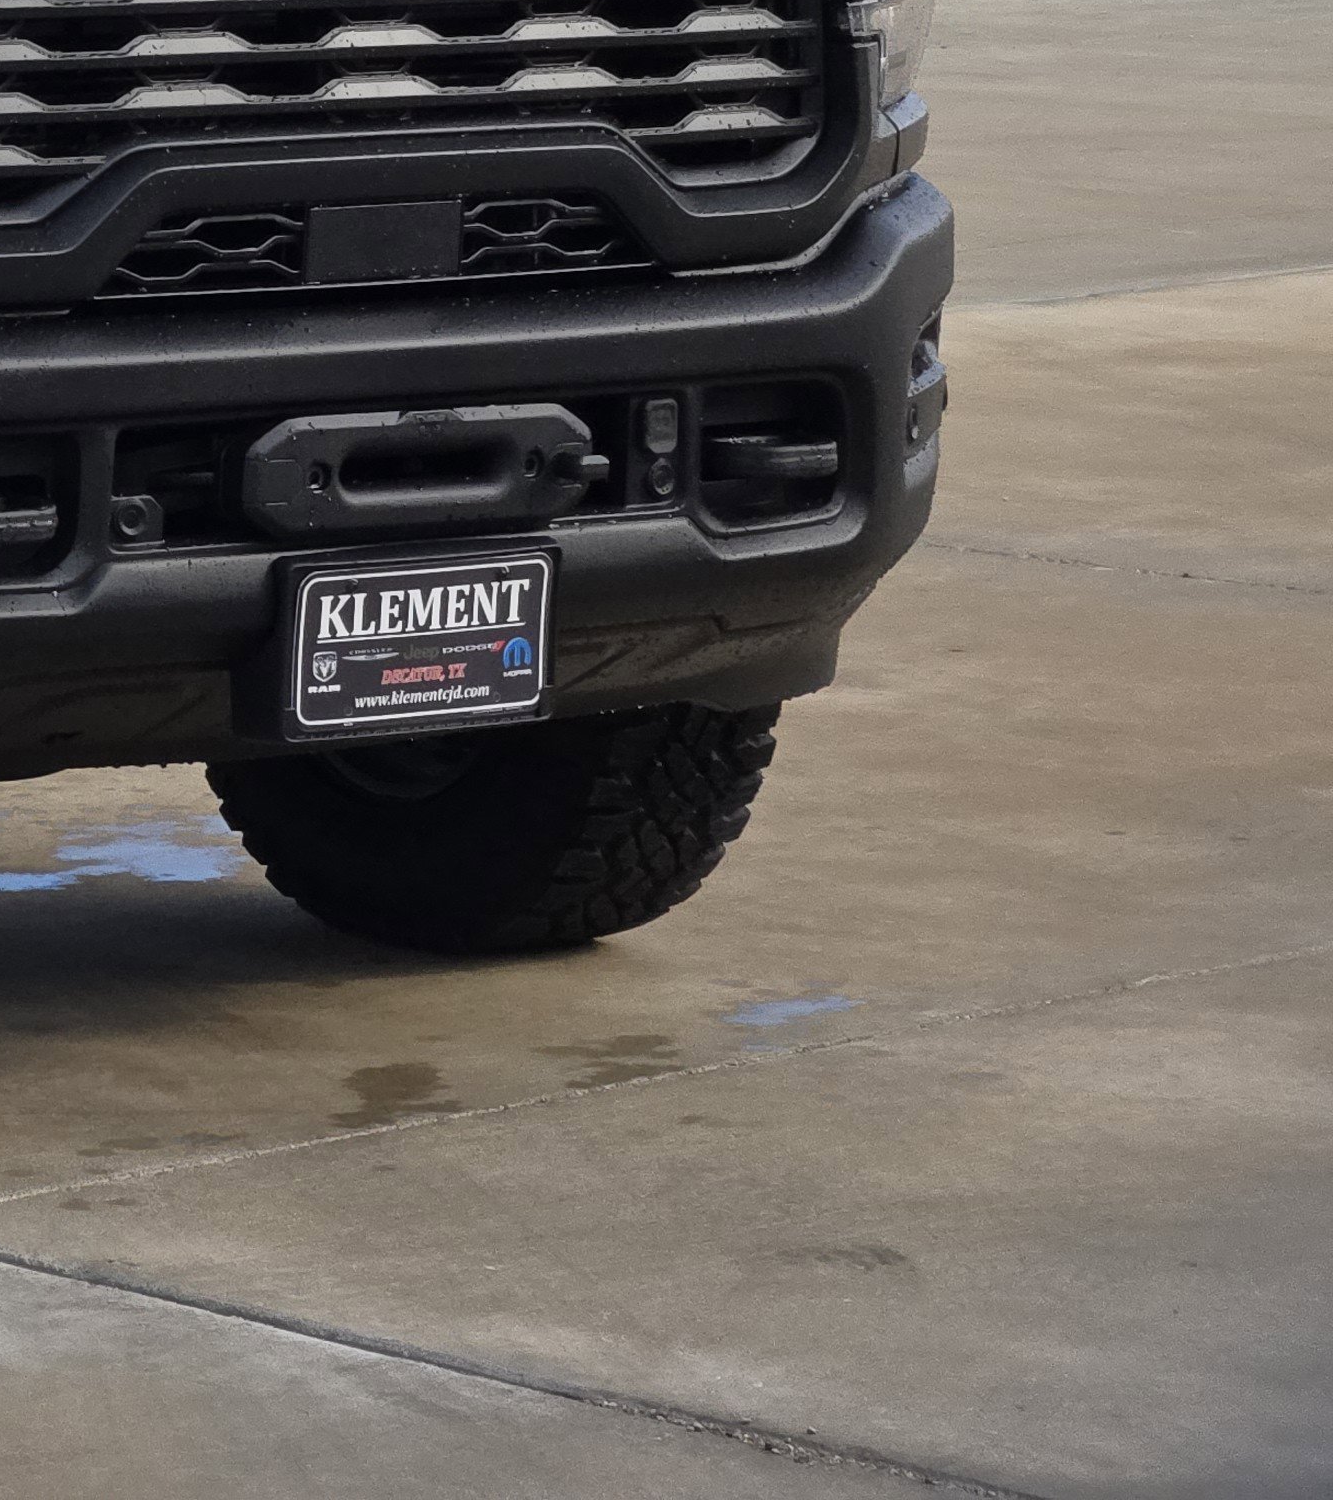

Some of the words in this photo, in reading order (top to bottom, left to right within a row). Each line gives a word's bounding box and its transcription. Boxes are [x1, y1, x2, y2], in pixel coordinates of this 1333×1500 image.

[317, 578, 530, 639] KLEMENT
[447, 662, 468, 679] TX
[307, 684, 342, 694] RAM
[354, 683, 490, 709] www.klementcjd.com
